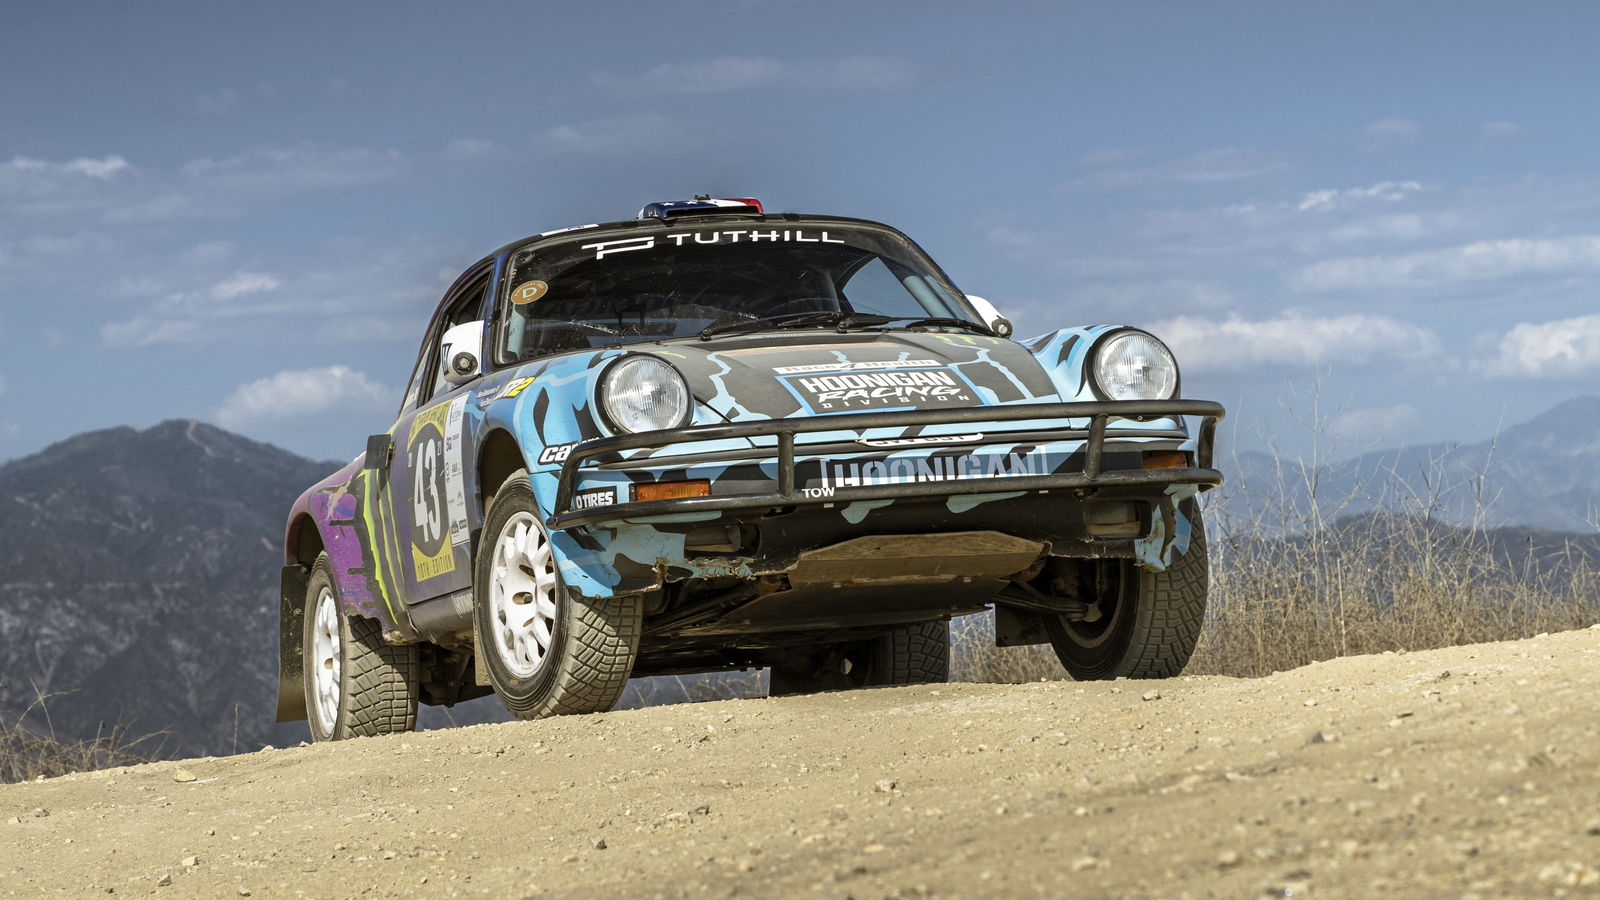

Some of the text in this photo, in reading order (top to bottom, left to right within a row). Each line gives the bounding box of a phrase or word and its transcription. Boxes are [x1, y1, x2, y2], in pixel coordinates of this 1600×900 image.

[666, 230, 845, 246] TUTHILL
[522, 287, 538, 299] D
[798, 371, 957, 394] HOONIGAN
[817, 385, 962, 404] RACING
[820, 394, 971, 409] DIVISION
[413, 438, 441, 543] 43
[802, 486, 835, 499] TOW
[432, 554, 453, 575] EDITION
